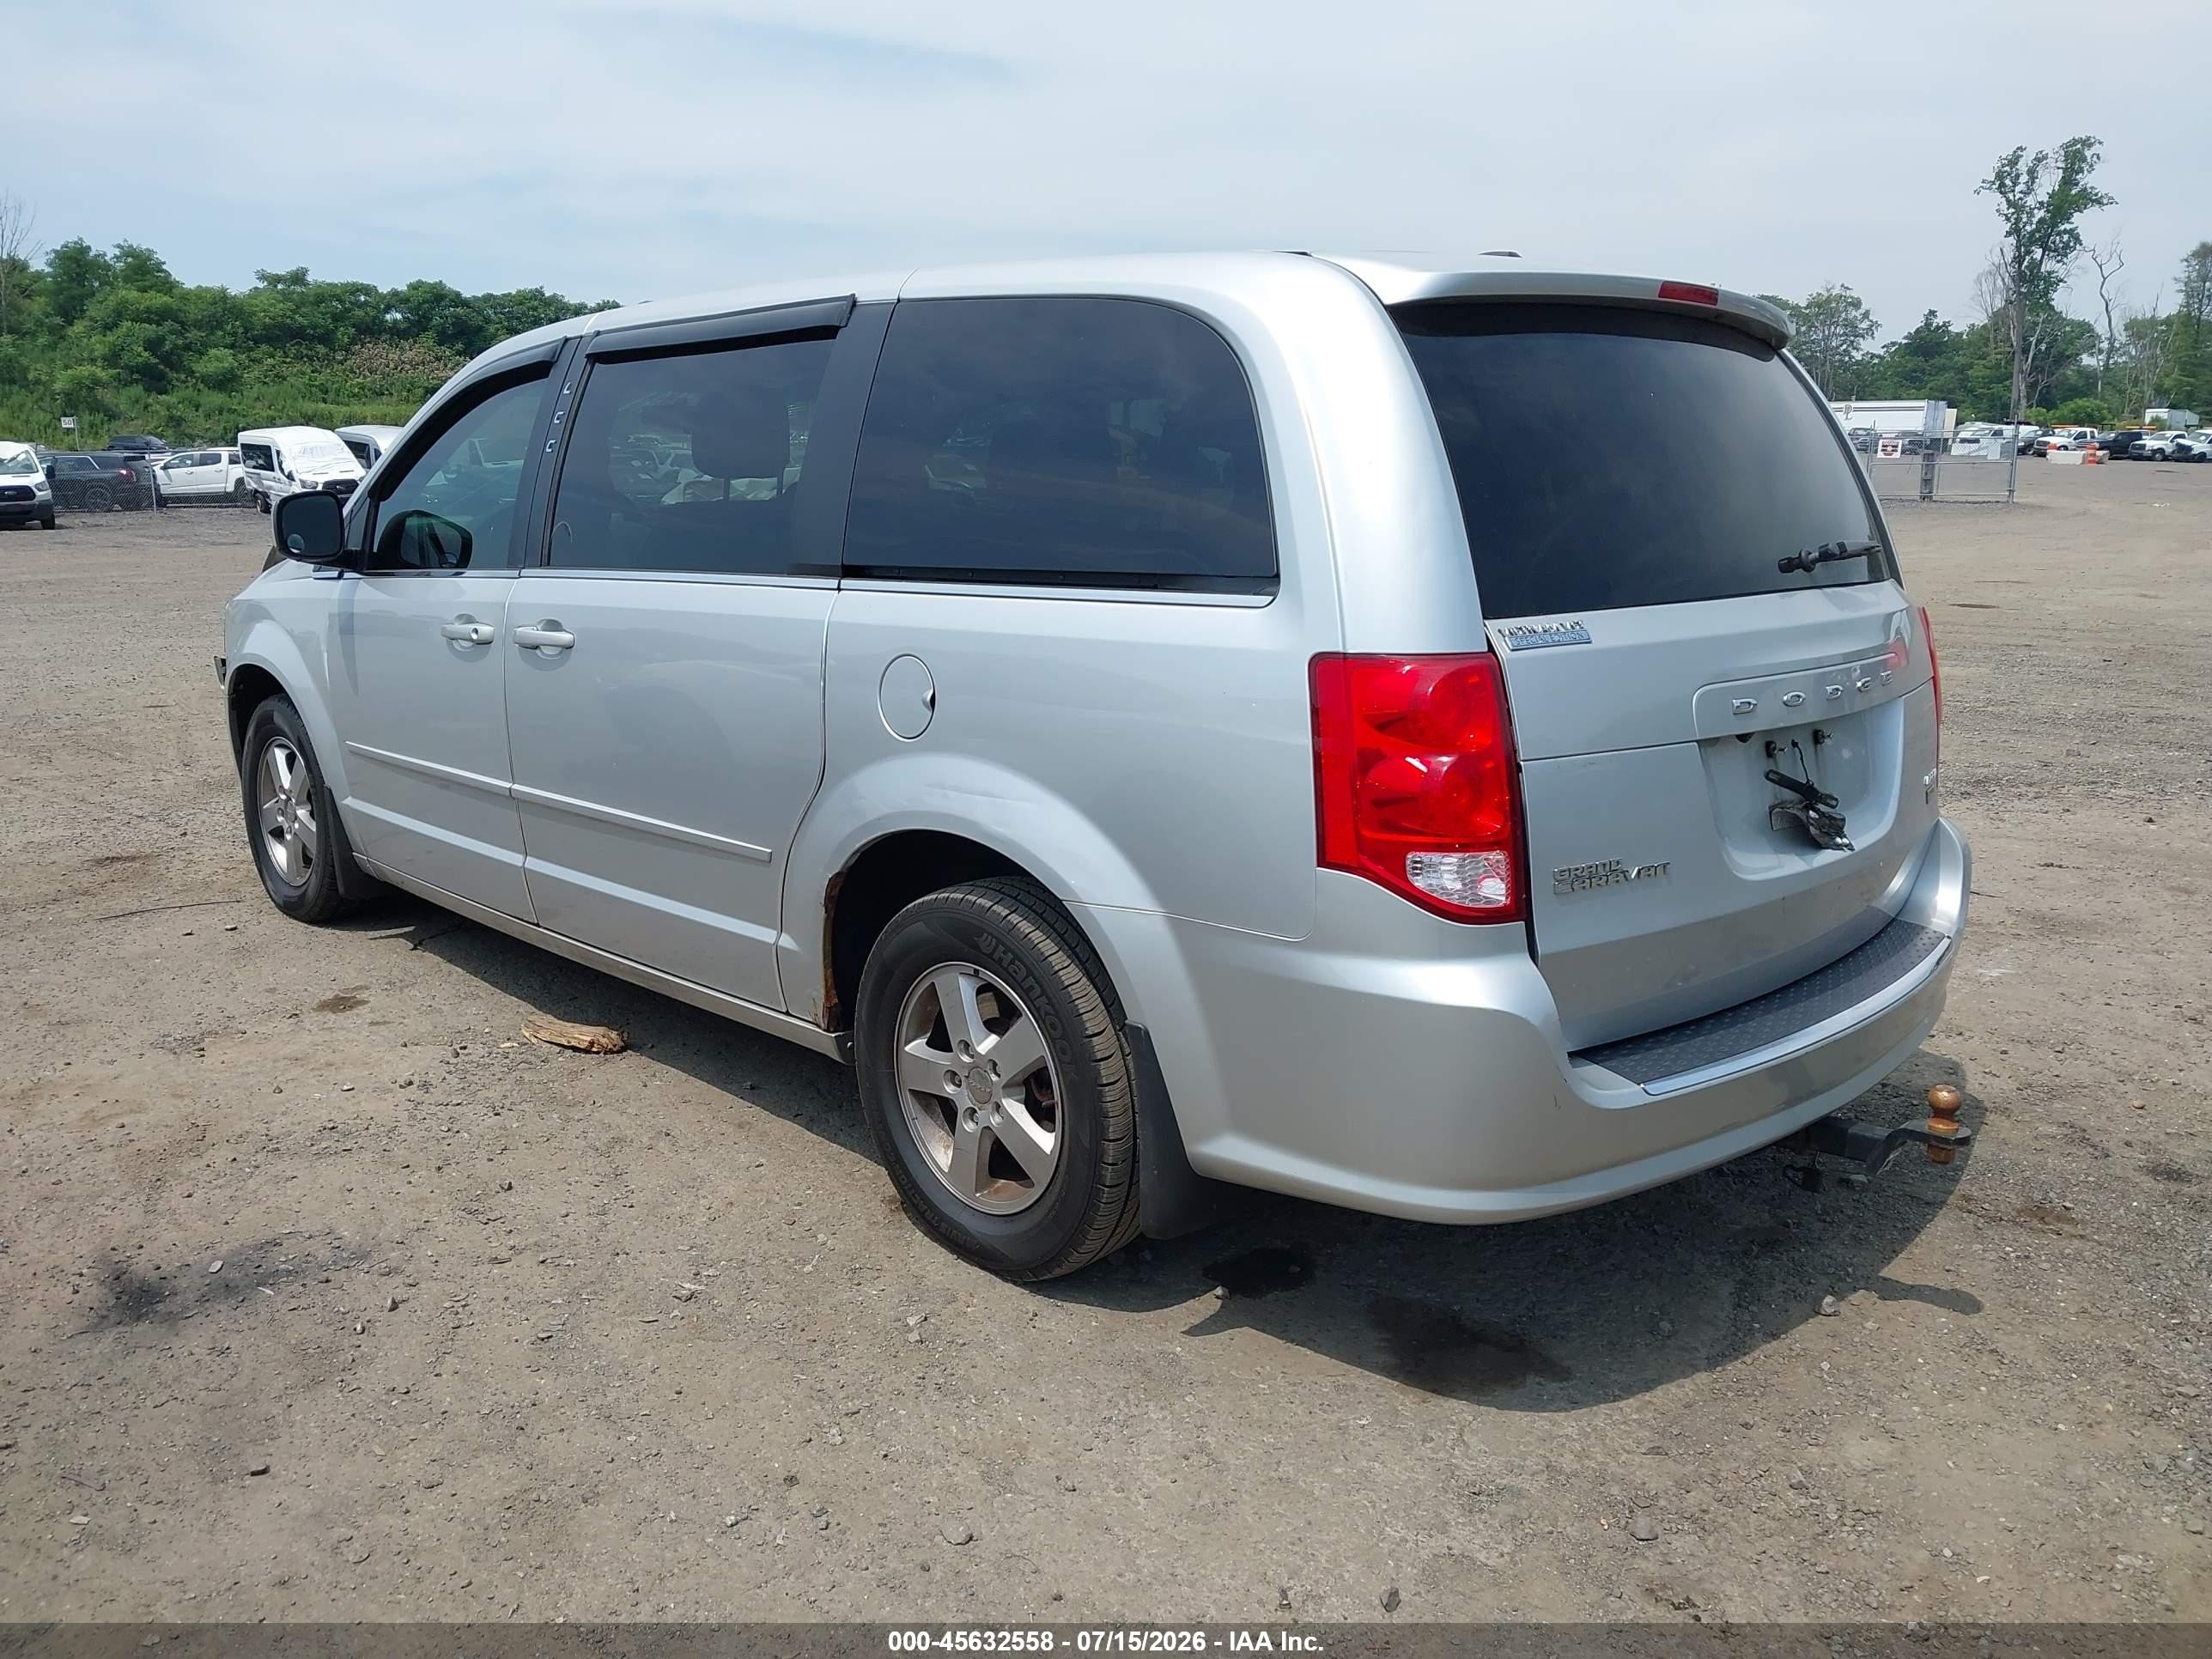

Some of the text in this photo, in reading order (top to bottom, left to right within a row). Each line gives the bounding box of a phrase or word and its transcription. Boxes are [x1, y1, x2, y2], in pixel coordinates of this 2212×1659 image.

[1732, 671, 1893, 715] DODGE
[1553, 858, 1622, 881] GRAND
[1553, 861, 1670, 895] CARAVAN
